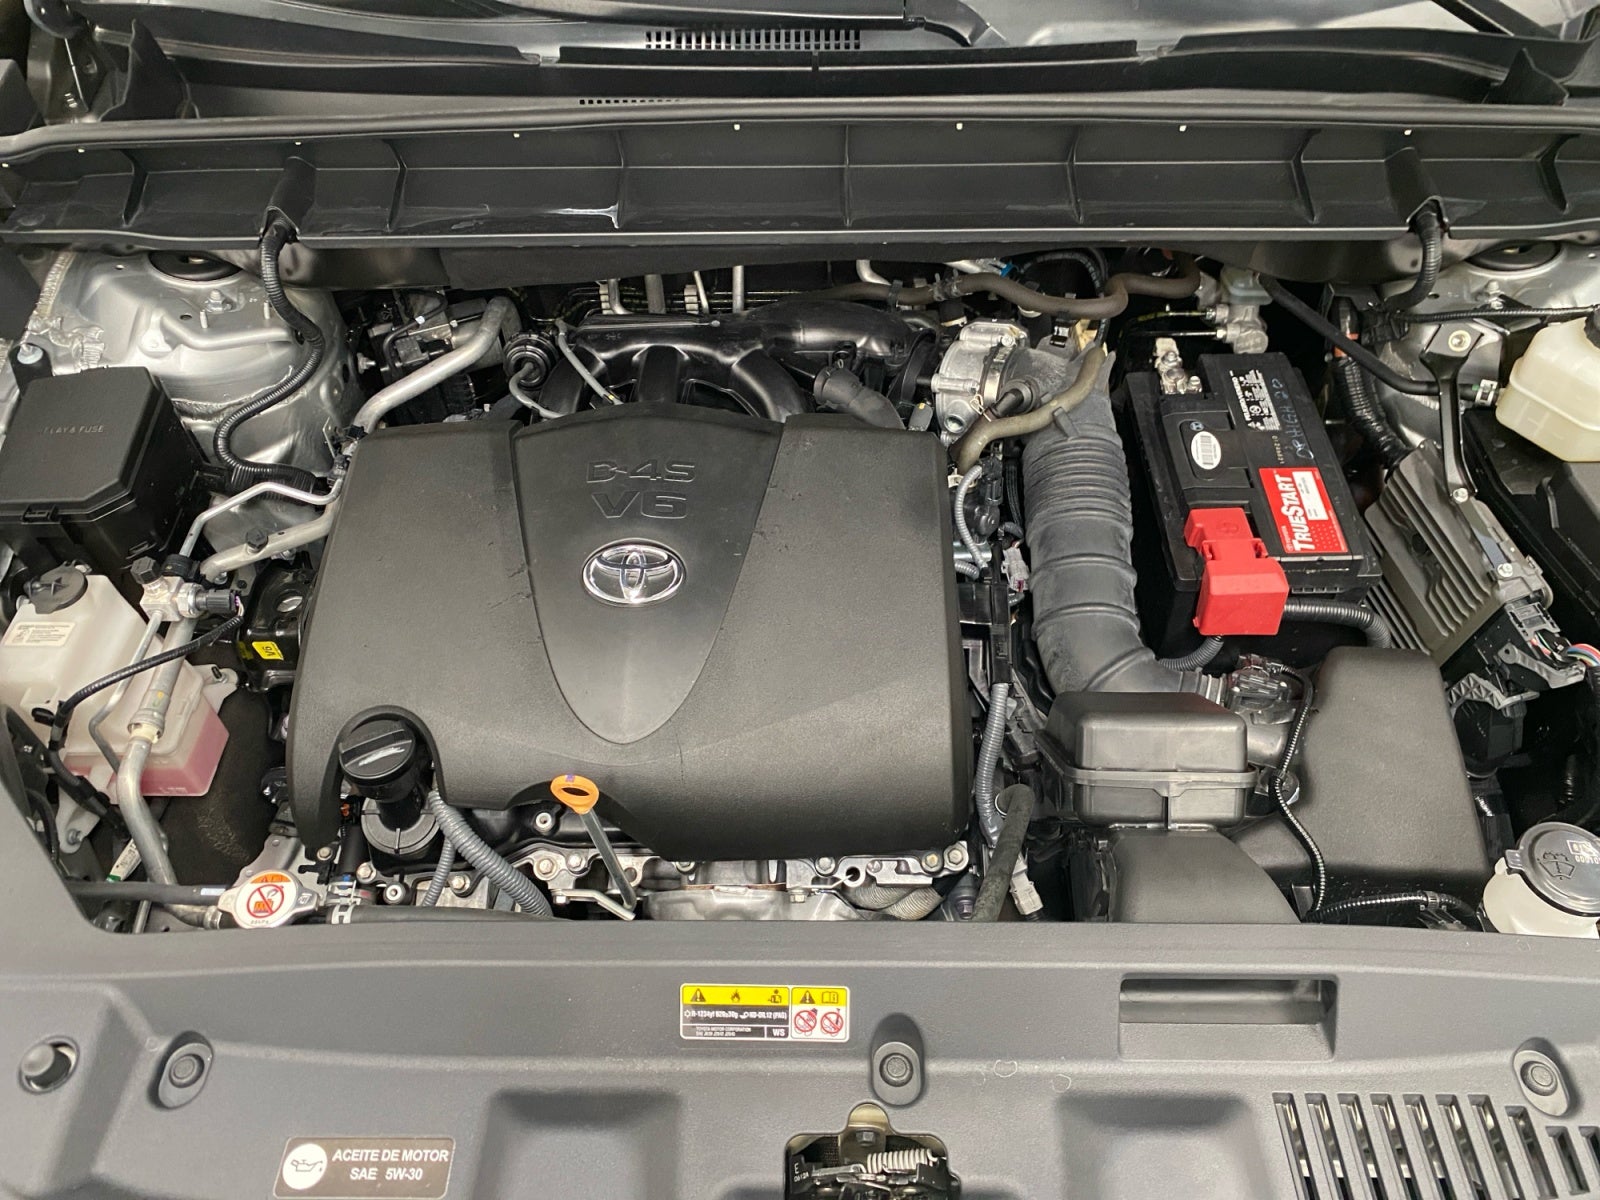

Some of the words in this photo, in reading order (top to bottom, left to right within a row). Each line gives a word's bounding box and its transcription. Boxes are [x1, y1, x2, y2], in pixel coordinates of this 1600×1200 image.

[79, 425, 104, 433] FUSE
[586, 460, 696, 483] D-4S
[591, 490, 687, 519] V6
[772, 1028, 785, 1037] WS
[332, 1149, 380, 1162] ACEITE
[381, 1150, 400, 1162] DE
[401, 1150, 449, 1162] MOTOR
[350, 1168, 378, 1180] SAE
[385, 1168, 423, 1180] 5W-30
